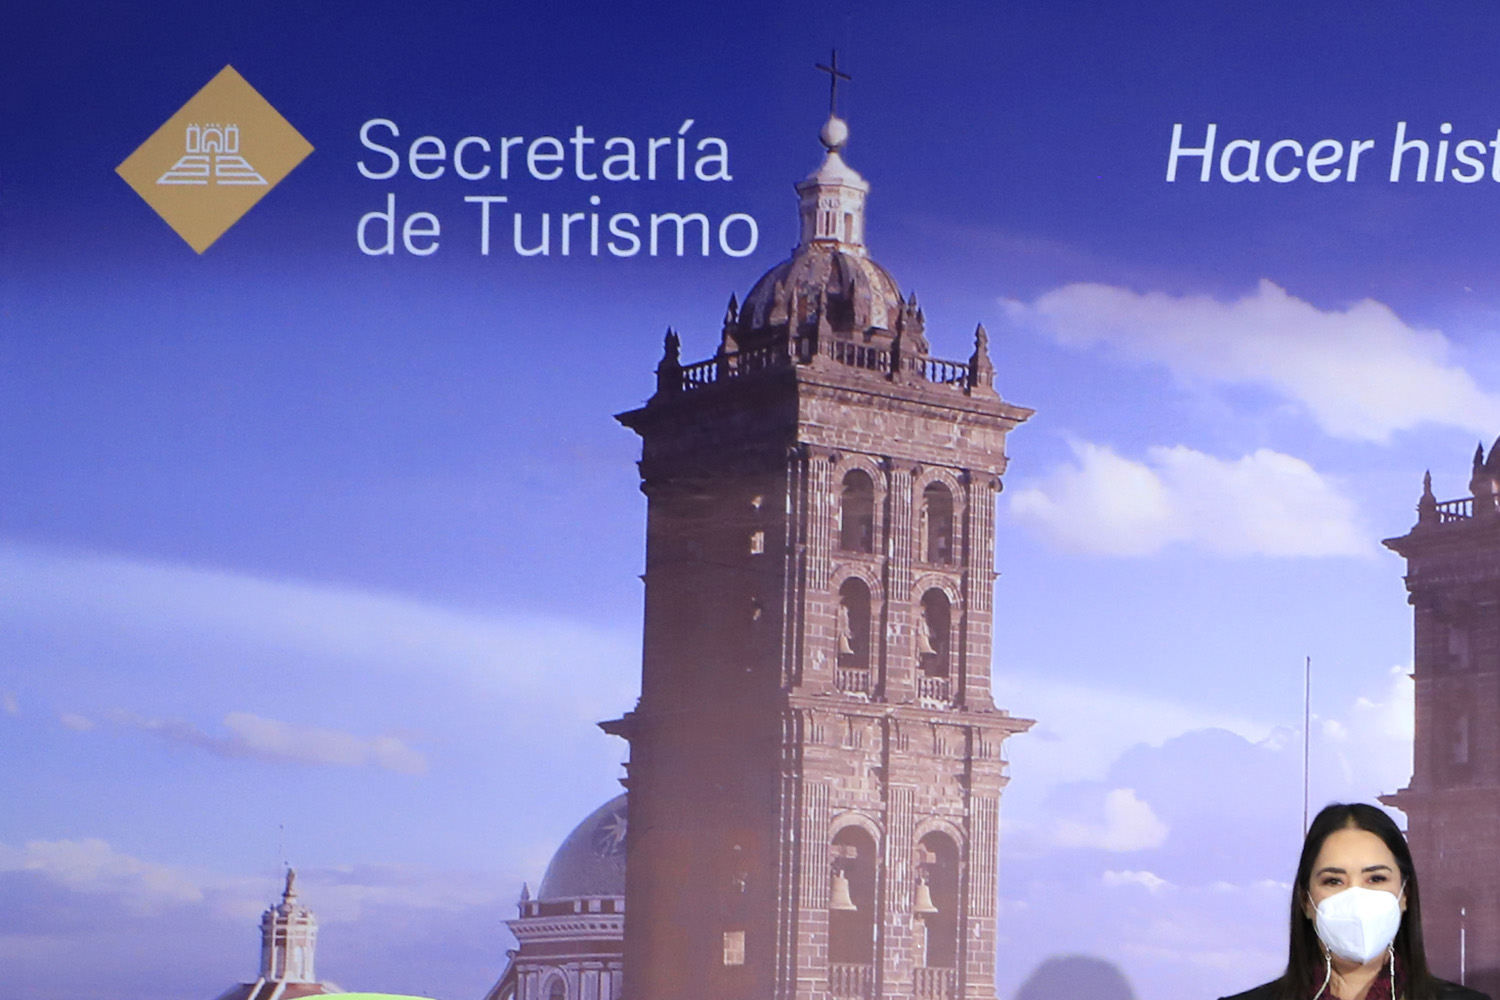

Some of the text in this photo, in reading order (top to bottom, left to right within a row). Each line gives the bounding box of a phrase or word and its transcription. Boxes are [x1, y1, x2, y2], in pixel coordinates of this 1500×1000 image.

[357, 119, 733, 181] Secretaría
[1166, 124, 1374, 182] Hacer
[357, 193, 758, 257] de Turismo
